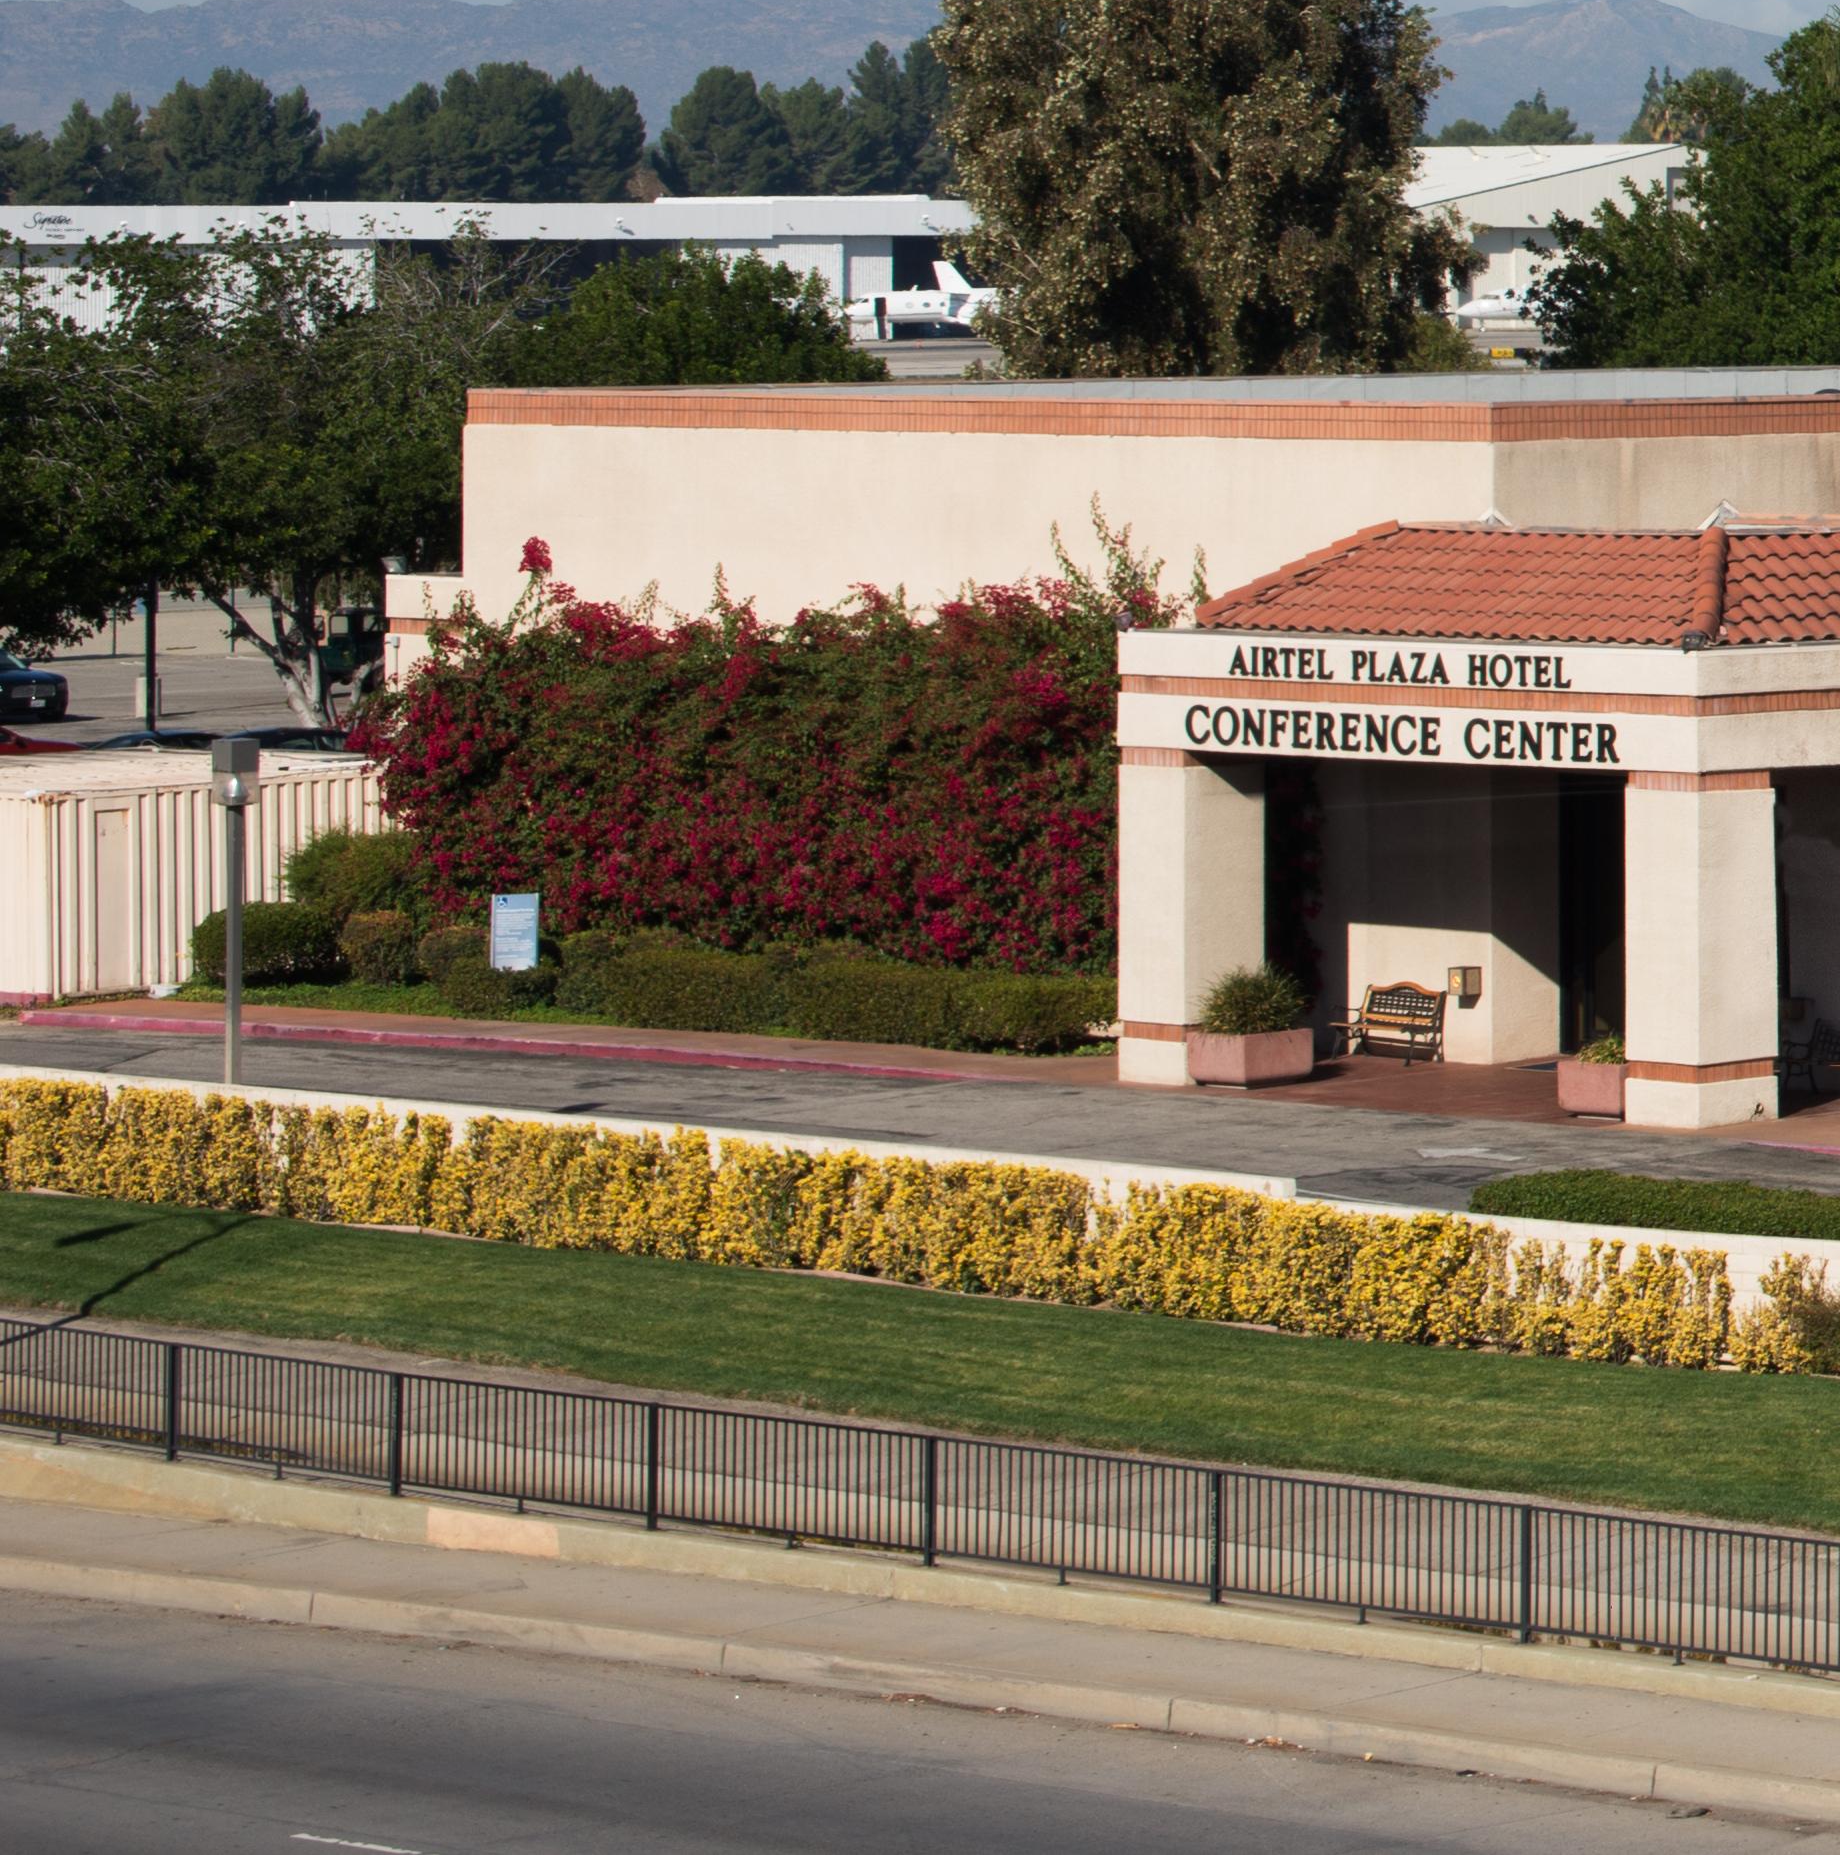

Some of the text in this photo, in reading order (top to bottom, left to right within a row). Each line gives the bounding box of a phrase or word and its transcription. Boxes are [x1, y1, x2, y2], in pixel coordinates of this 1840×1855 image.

[1229, 644, 1573, 689] AIRTEL PLAZA HOTEL
[1185, 703, 1621, 764] CONFERENCE CENTER
